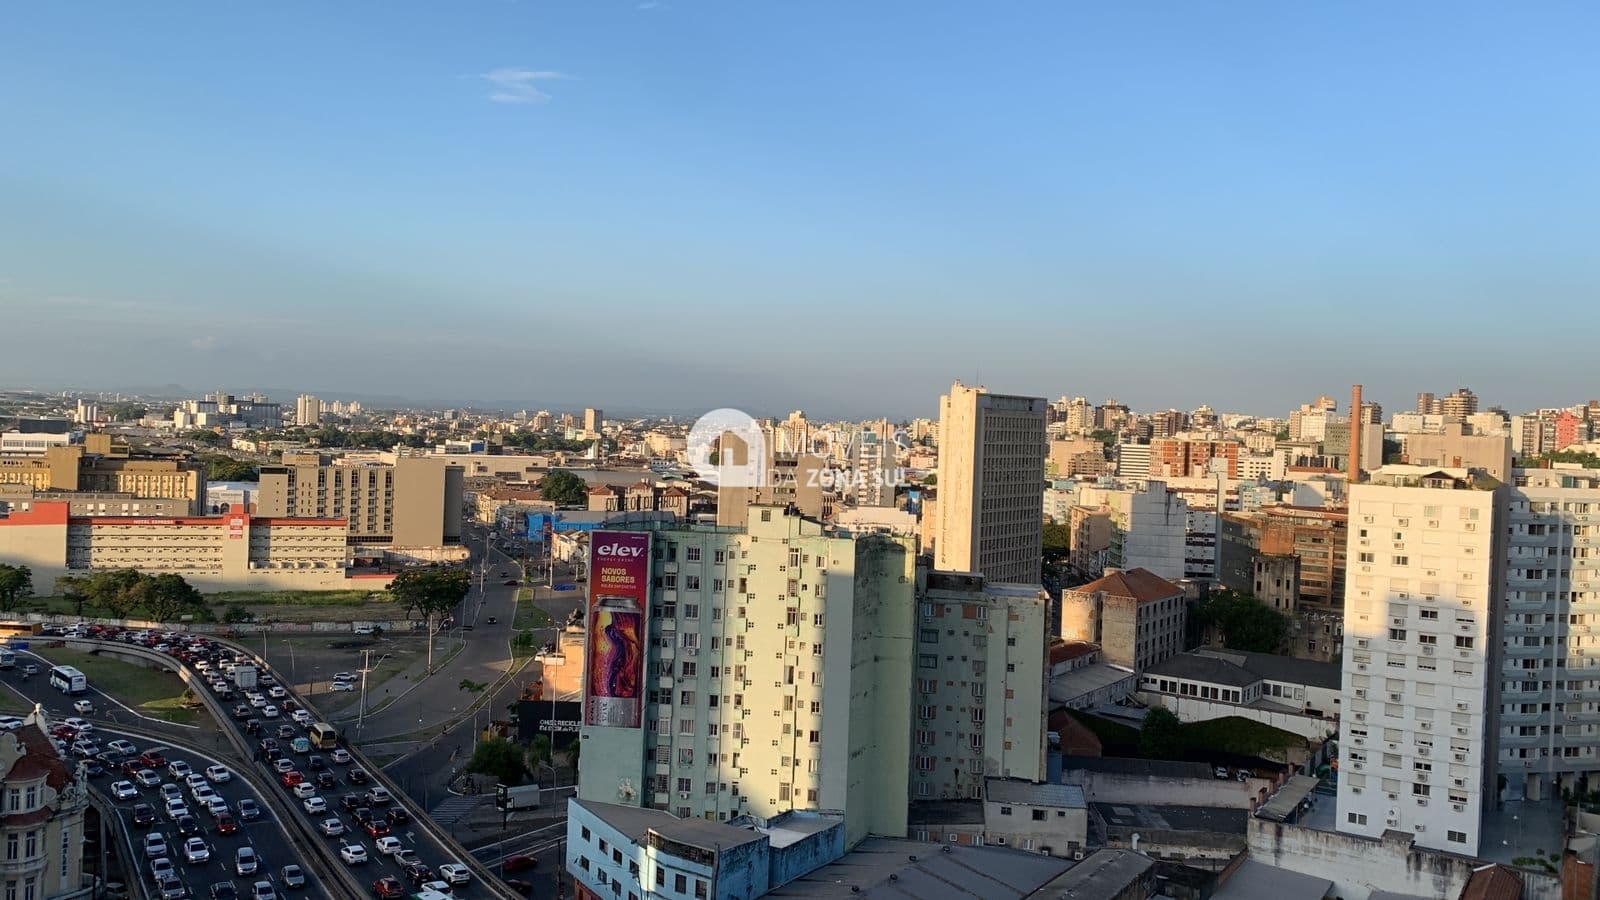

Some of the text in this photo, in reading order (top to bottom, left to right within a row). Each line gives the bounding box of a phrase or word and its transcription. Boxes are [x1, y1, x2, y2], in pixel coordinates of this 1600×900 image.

[597, 543, 644, 557] elev
[601, 567, 627, 575] NOVOS
[601, 575, 635, 584] SABORES
